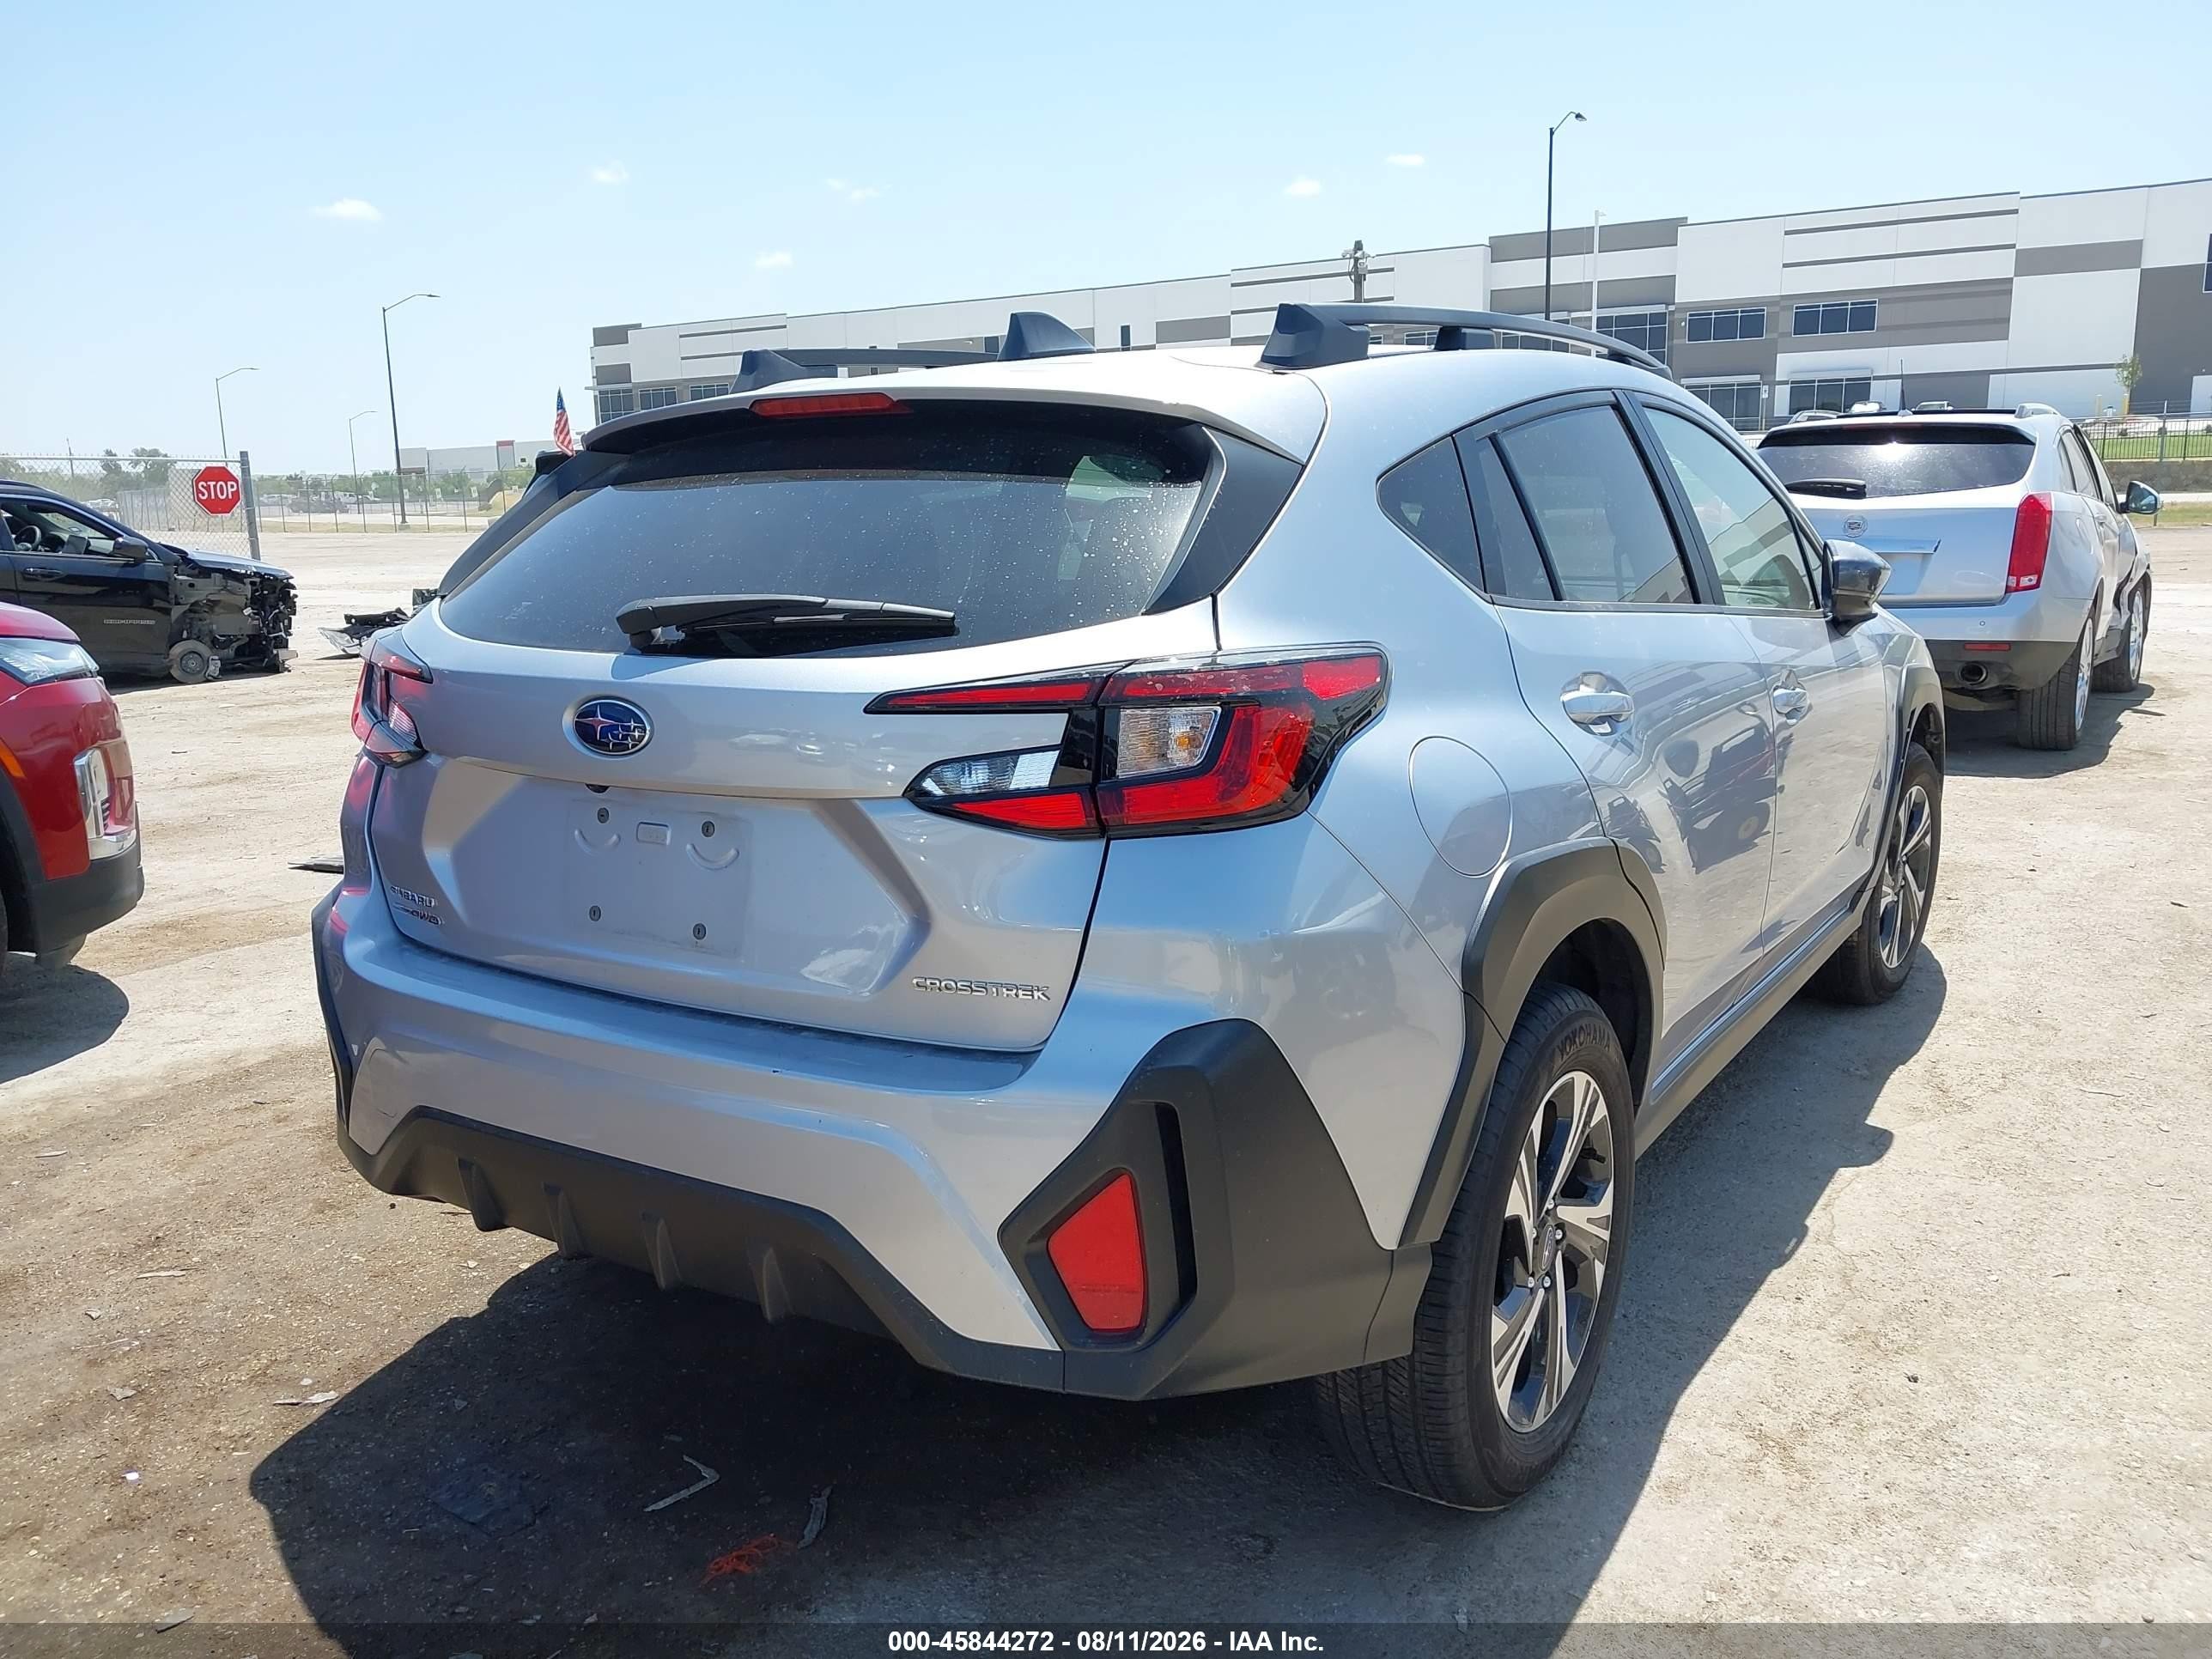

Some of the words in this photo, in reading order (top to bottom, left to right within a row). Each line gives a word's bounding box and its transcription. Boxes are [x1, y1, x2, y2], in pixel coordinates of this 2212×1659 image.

[198, 481, 237, 500] STOP
[391, 885, 435, 908] SUBARU
[912, 976, 1051, 1001] CROSSTREK
[1557, 1023, 1611, 1060] YOKOHAMA
